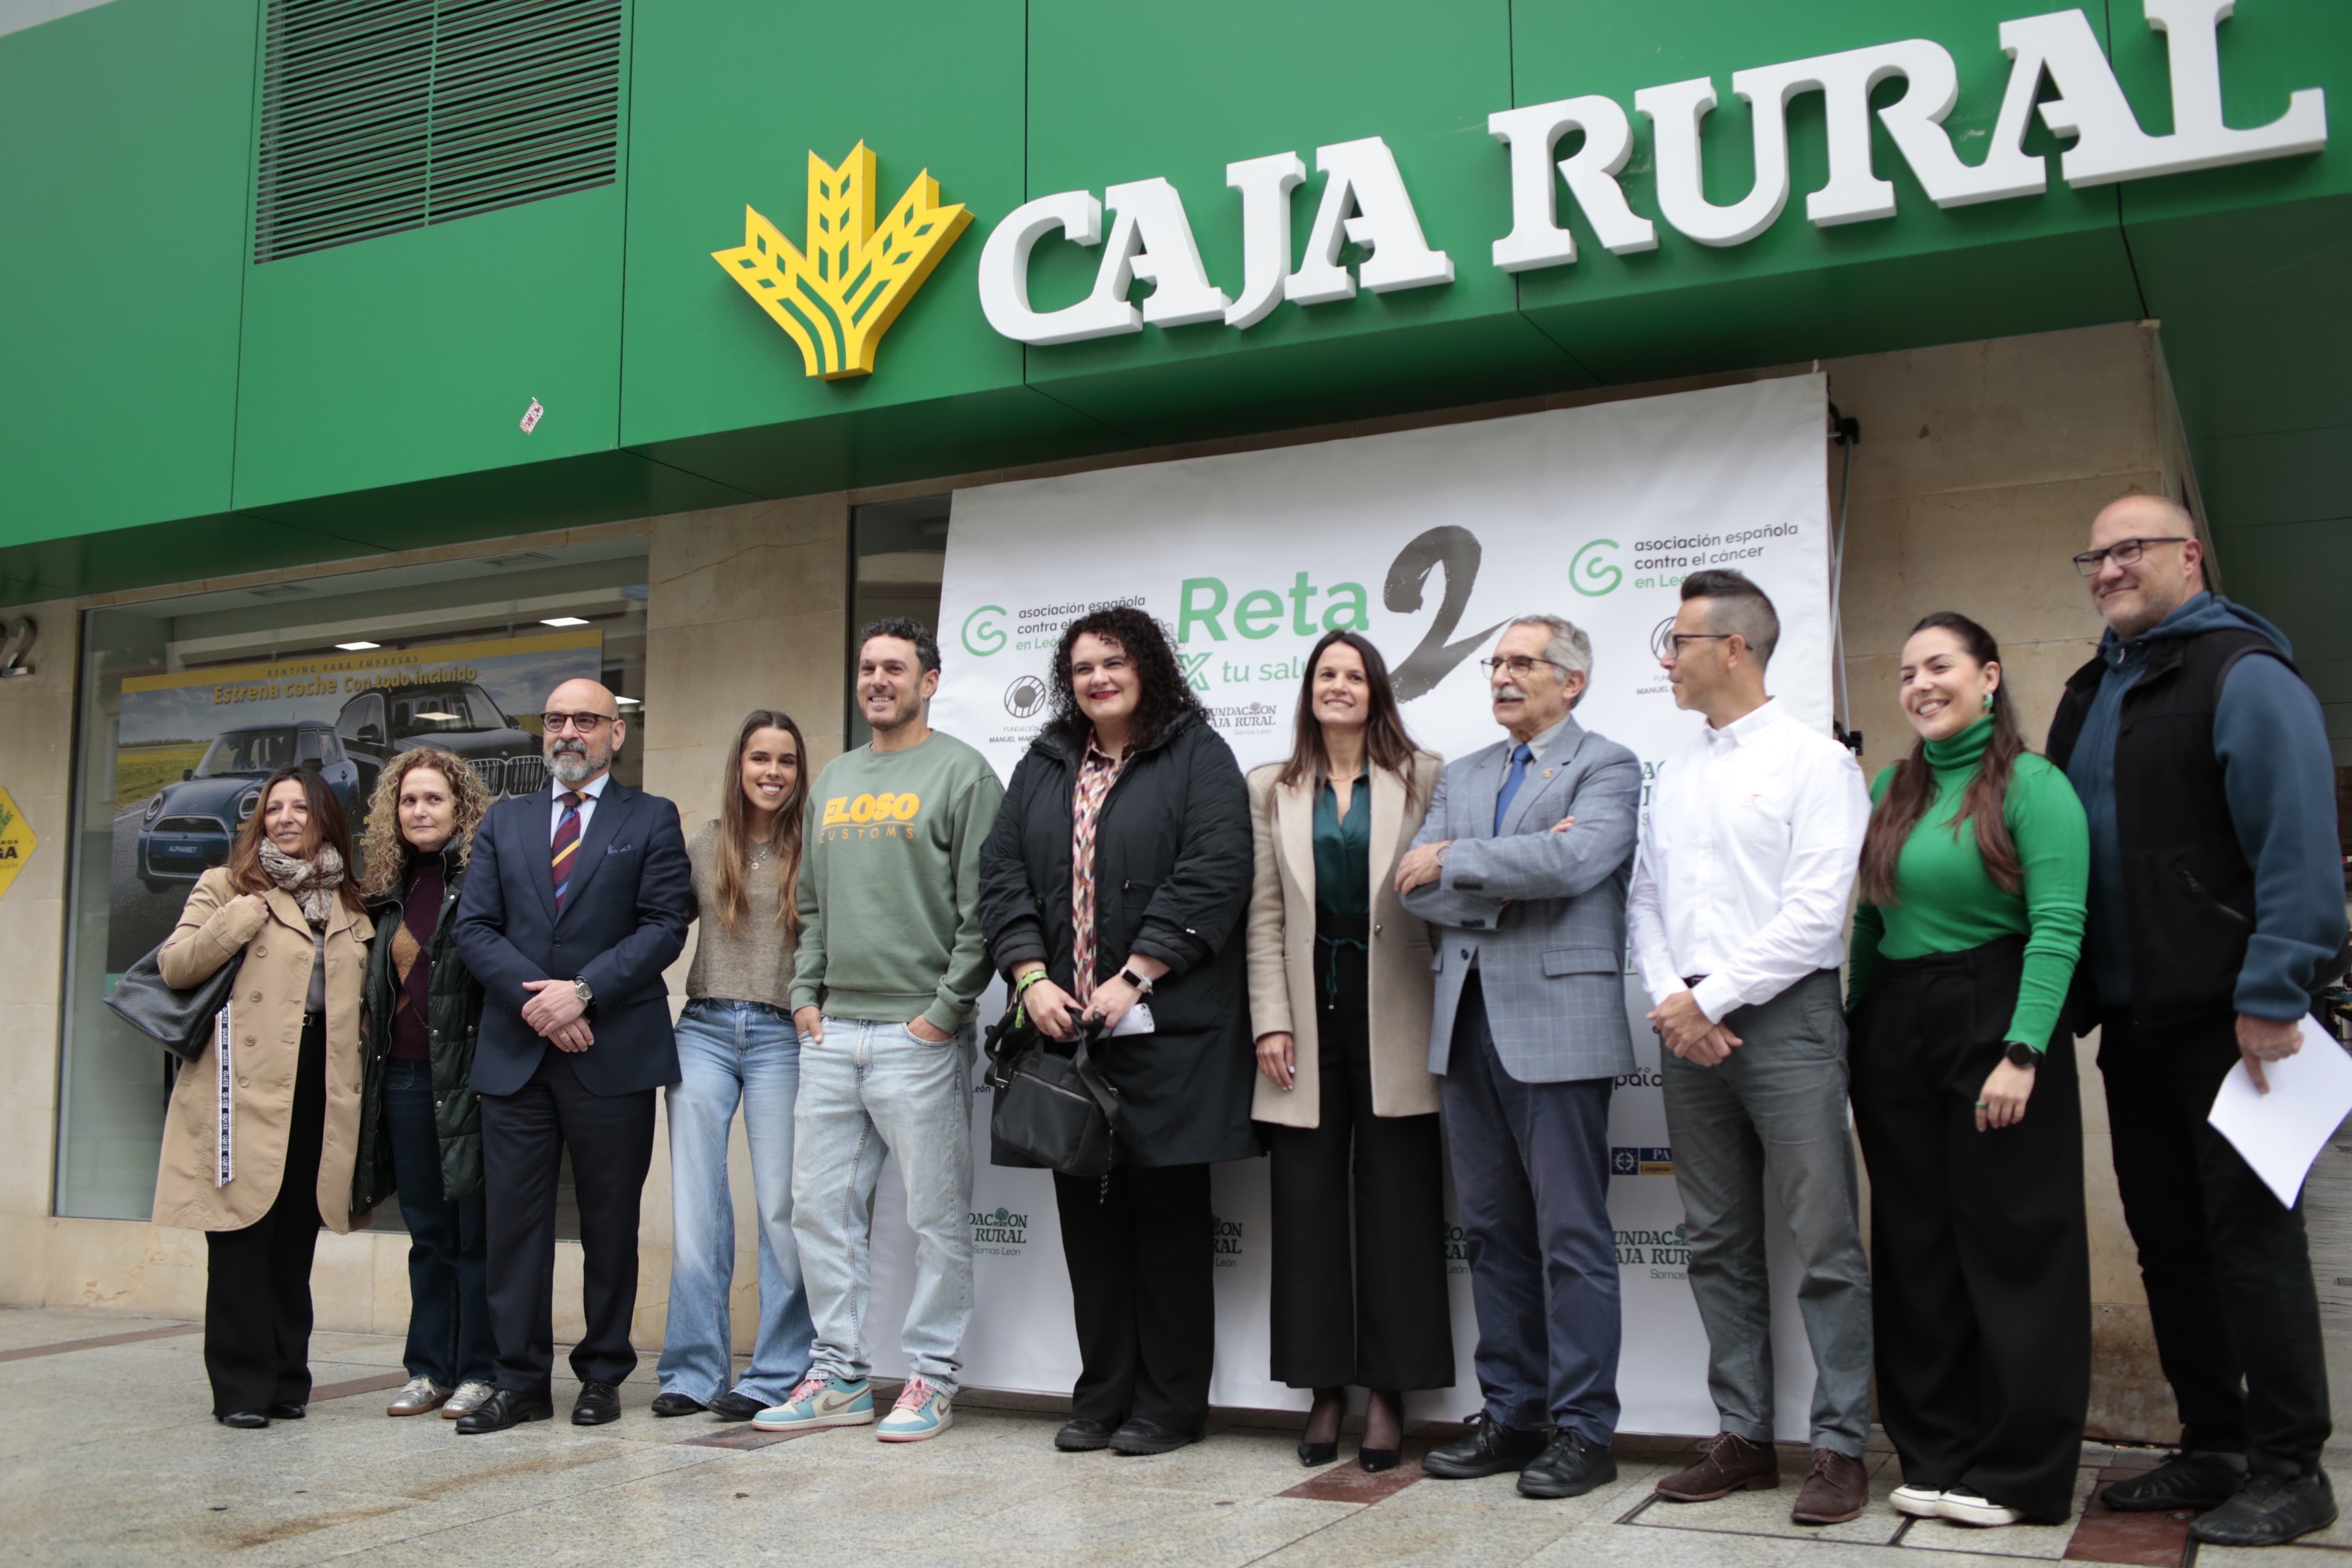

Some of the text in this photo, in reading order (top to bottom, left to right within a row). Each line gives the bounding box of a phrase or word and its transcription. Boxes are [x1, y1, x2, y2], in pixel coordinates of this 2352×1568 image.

[978, 0, 2326, 345] CAJA RURAL
[1634, 522, 1798, 551] asociación española
[1634, 545, 1764, 569] contra el cáncer
[1635, 577, 1654, 589] en
[1019, 595, 1145, 618] asociación española
[1178, 571, 1369, 643] Reta
[1018, 618, 1072, 634] contra el
[1016, 636, 1059, 650] en Leó
[267, 655, 418, 677] RENTING PARA EMPRESAS
[1222, 661, 1249, 682] tu
[213, 665, 477, 704] Estrena coche Con todo incluido
[1637, 685, 1669, 695] MANUEL
[1211, 716, 1275, 728] AJA RURAL
[820, 827, 915, 844] CUSTOMS
[973, 1085, 991, 1093] eón
[974, 1228, 1026, 1243] RURAL
[972, 1245, 1021, 1257] Somos León
[1616, 1248, 1645, 1265] AJA
[1216, 1258, 1237, 1267] León
[1650, 1268, 1687, 1280] Somos
